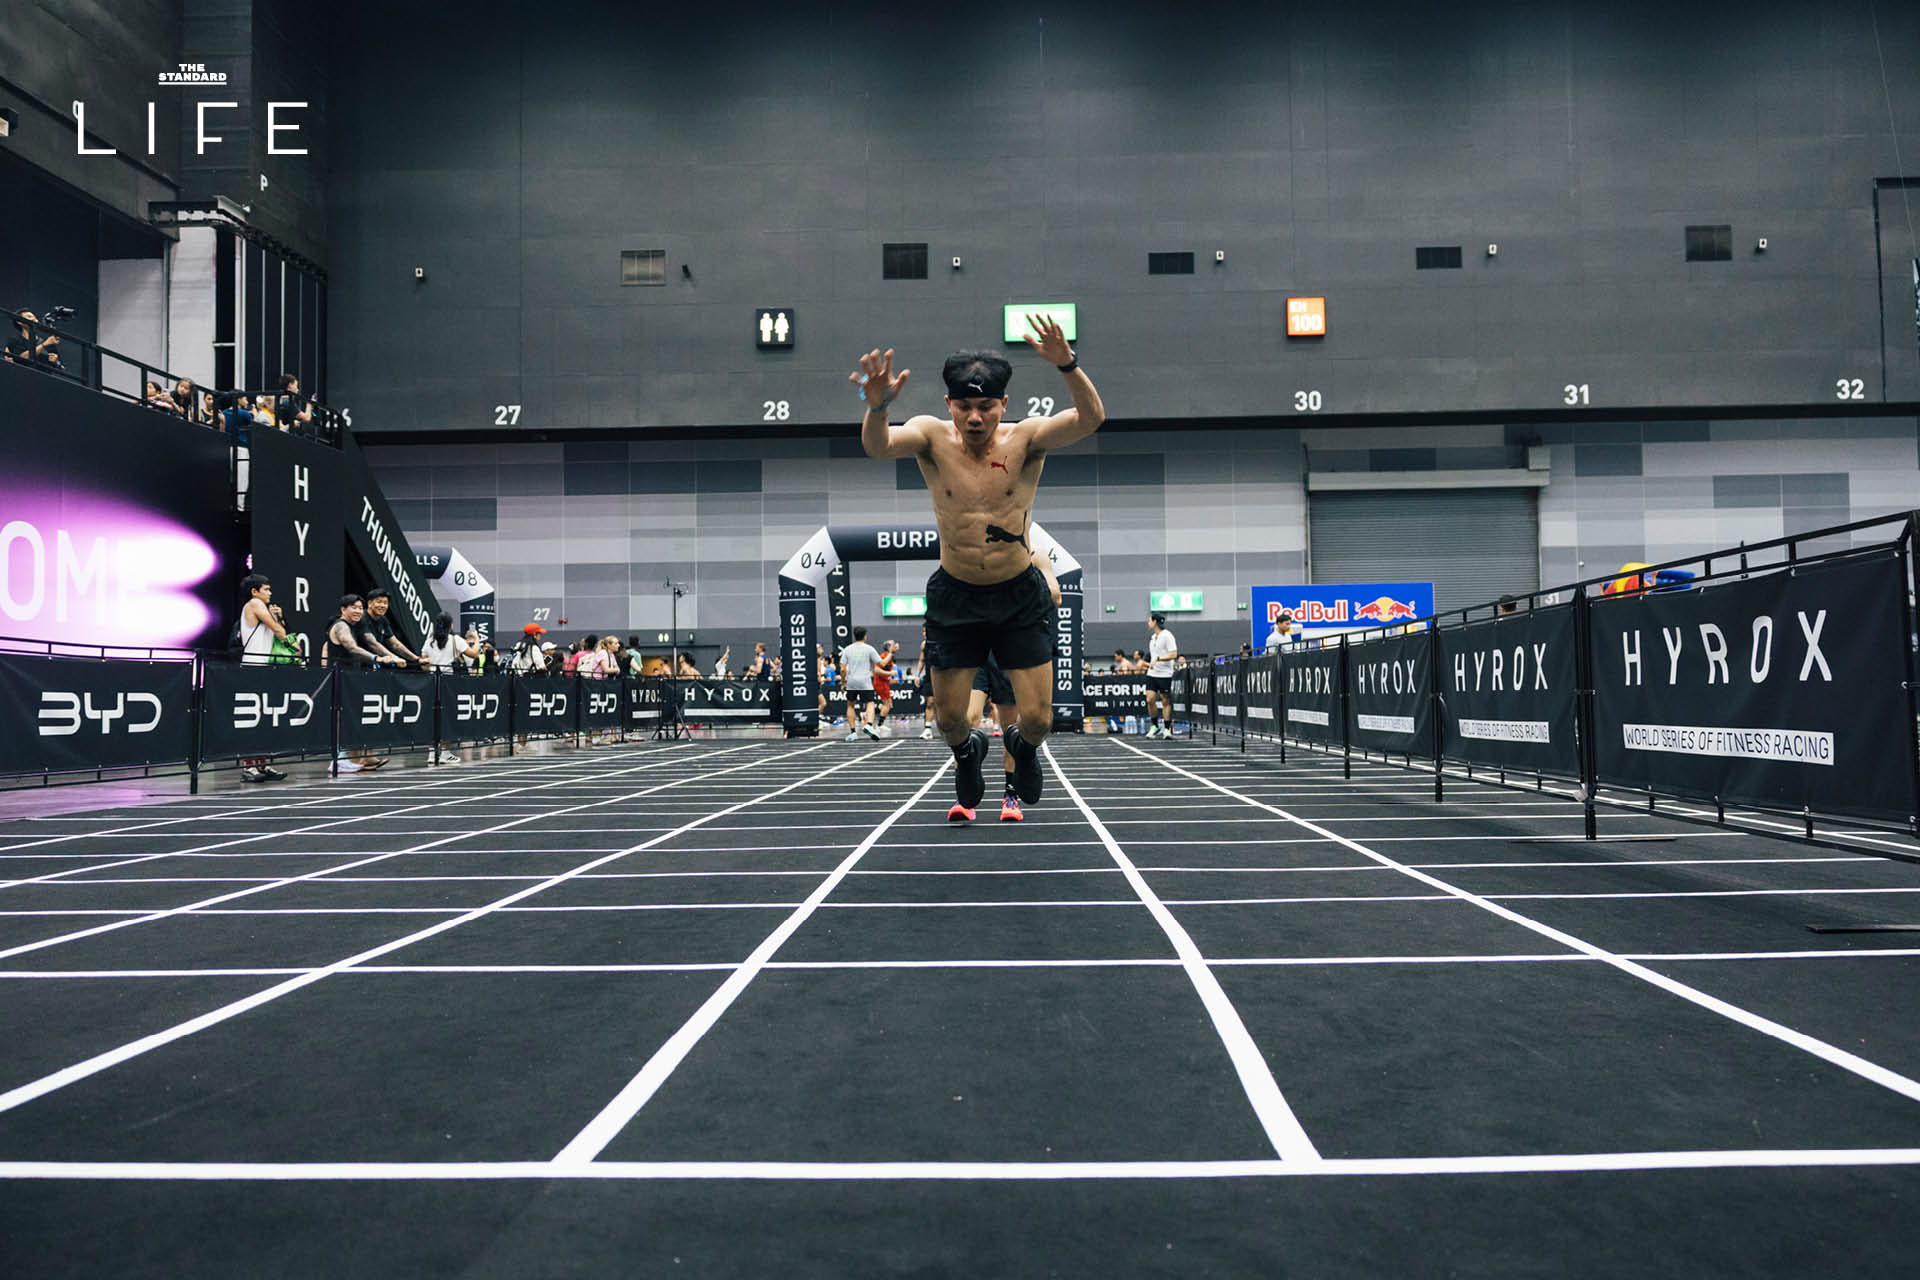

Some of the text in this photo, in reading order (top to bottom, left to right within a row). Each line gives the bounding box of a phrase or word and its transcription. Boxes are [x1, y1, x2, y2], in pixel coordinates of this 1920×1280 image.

[1291, 314, 1323, 331] 100
[1564, 384, 1590, 405] 31
[1836, 379, 1864, 399] 32
[763, 400, 790, 421] 28
[1027, 397, 1054, 417] 29
[1294, 391, 1321, 411] 30
[495, 405, 521, 425] 27
[877, 531, 938, 549] BURP
[294, 464, 309, 669] HYRO
[416, 555, 440, 566] LLS
[801, 552, 827, 569] 04
[454, 571, 478, 586] 08
[533, 607, 551, 621] 27
[1308, 600, 1349, 623] Bull
[791, 614, 807, 697] BURPEES
[1057, 607, 1072, 691] BURPEES
[1621, 609, 1833, 687] HYROX
[1358, 659, 1416, 694] HYROX
[1454, 643, 1549, 692] HYROX
[1104, 685, 1130, 696] FOR
[1132, 684, 1147, 696] IM
[1289, 667, 1331, 695] HYROX
[528, 693, 567, 717] BYD
[589, 693, 617, 714] BYD
[684, 687, 771, 702] HYROX
[38, 691, 162, 736] BYD
[233, 692, 314, 729] BYD
[361, 694, 421, 725] BYD
[456, 694, 499, 720] BYD
[1625, 728, 1829, 760] WORLD SERIES OF FITNESS RACING
